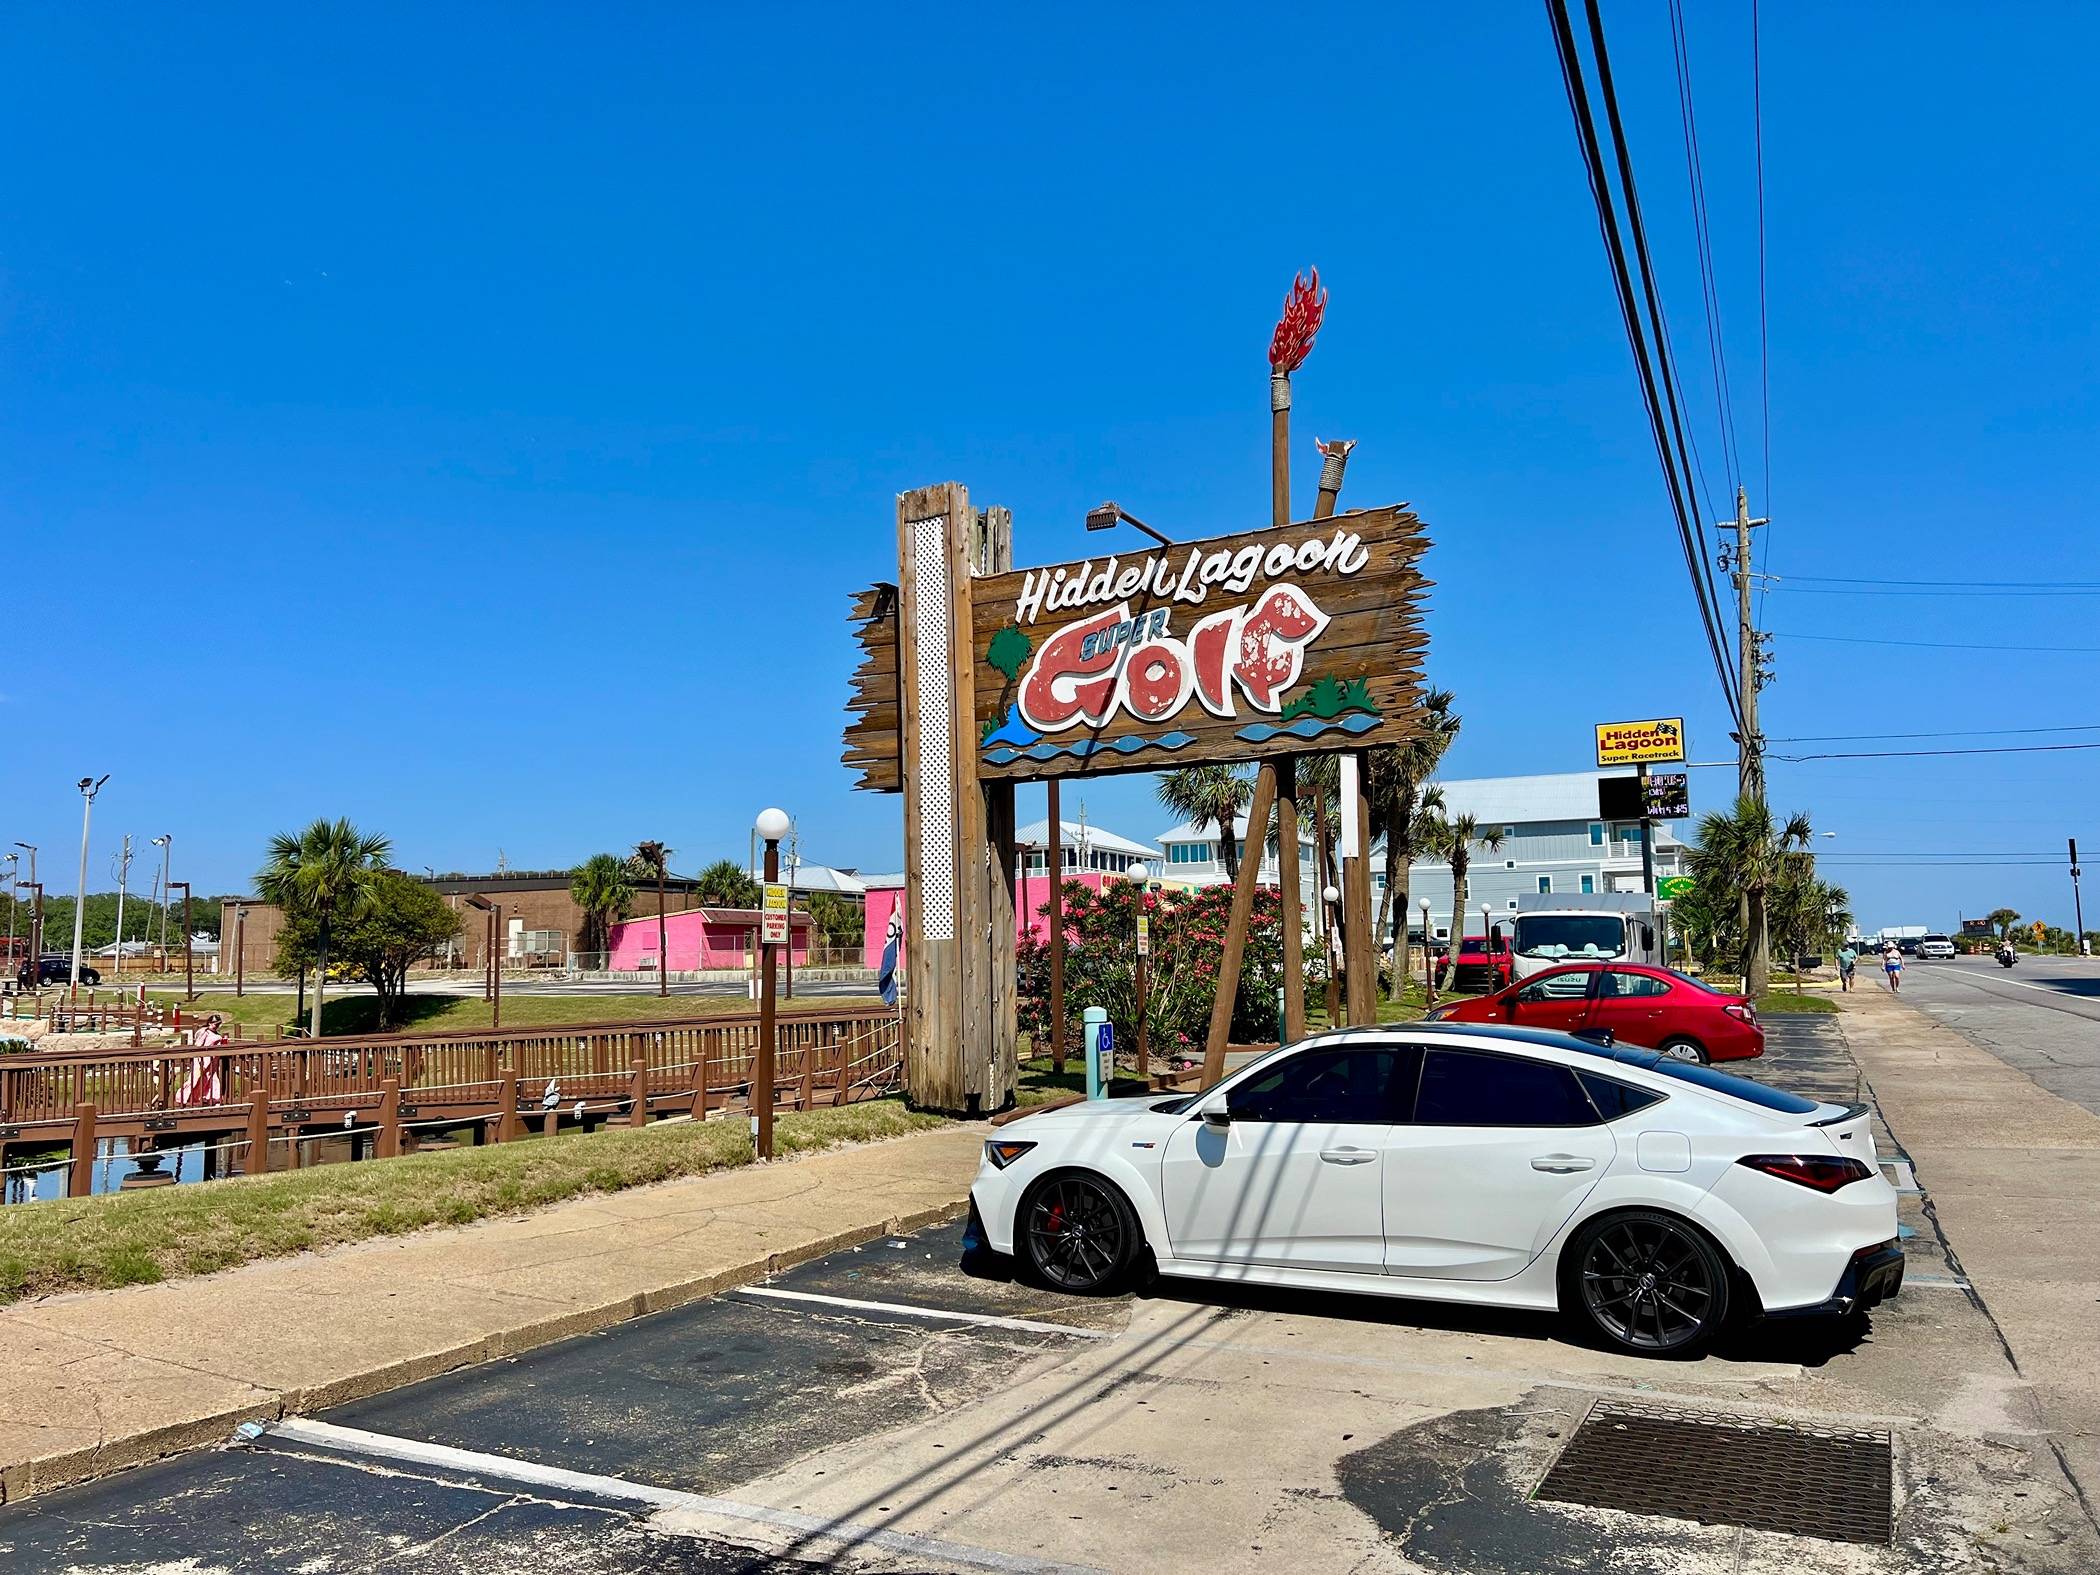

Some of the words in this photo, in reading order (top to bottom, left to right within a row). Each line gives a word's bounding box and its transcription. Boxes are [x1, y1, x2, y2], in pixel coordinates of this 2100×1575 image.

[1015, 555, 1177, 625] Hidden
[1172, 529, 1370, 604] Lagoon
[1080, 608, 1168, 662] SUPER
[1606, 729, 1660, 741] Hidden
[1600, 736, 1678, 751] Lagoon
[1601, 754, 1629, 763] Super
[1631, 749, 1680, 760] Racetrack
[765, 913, 787, 921] CUSTOMER
[767, 922, 785, 930] PARKING
